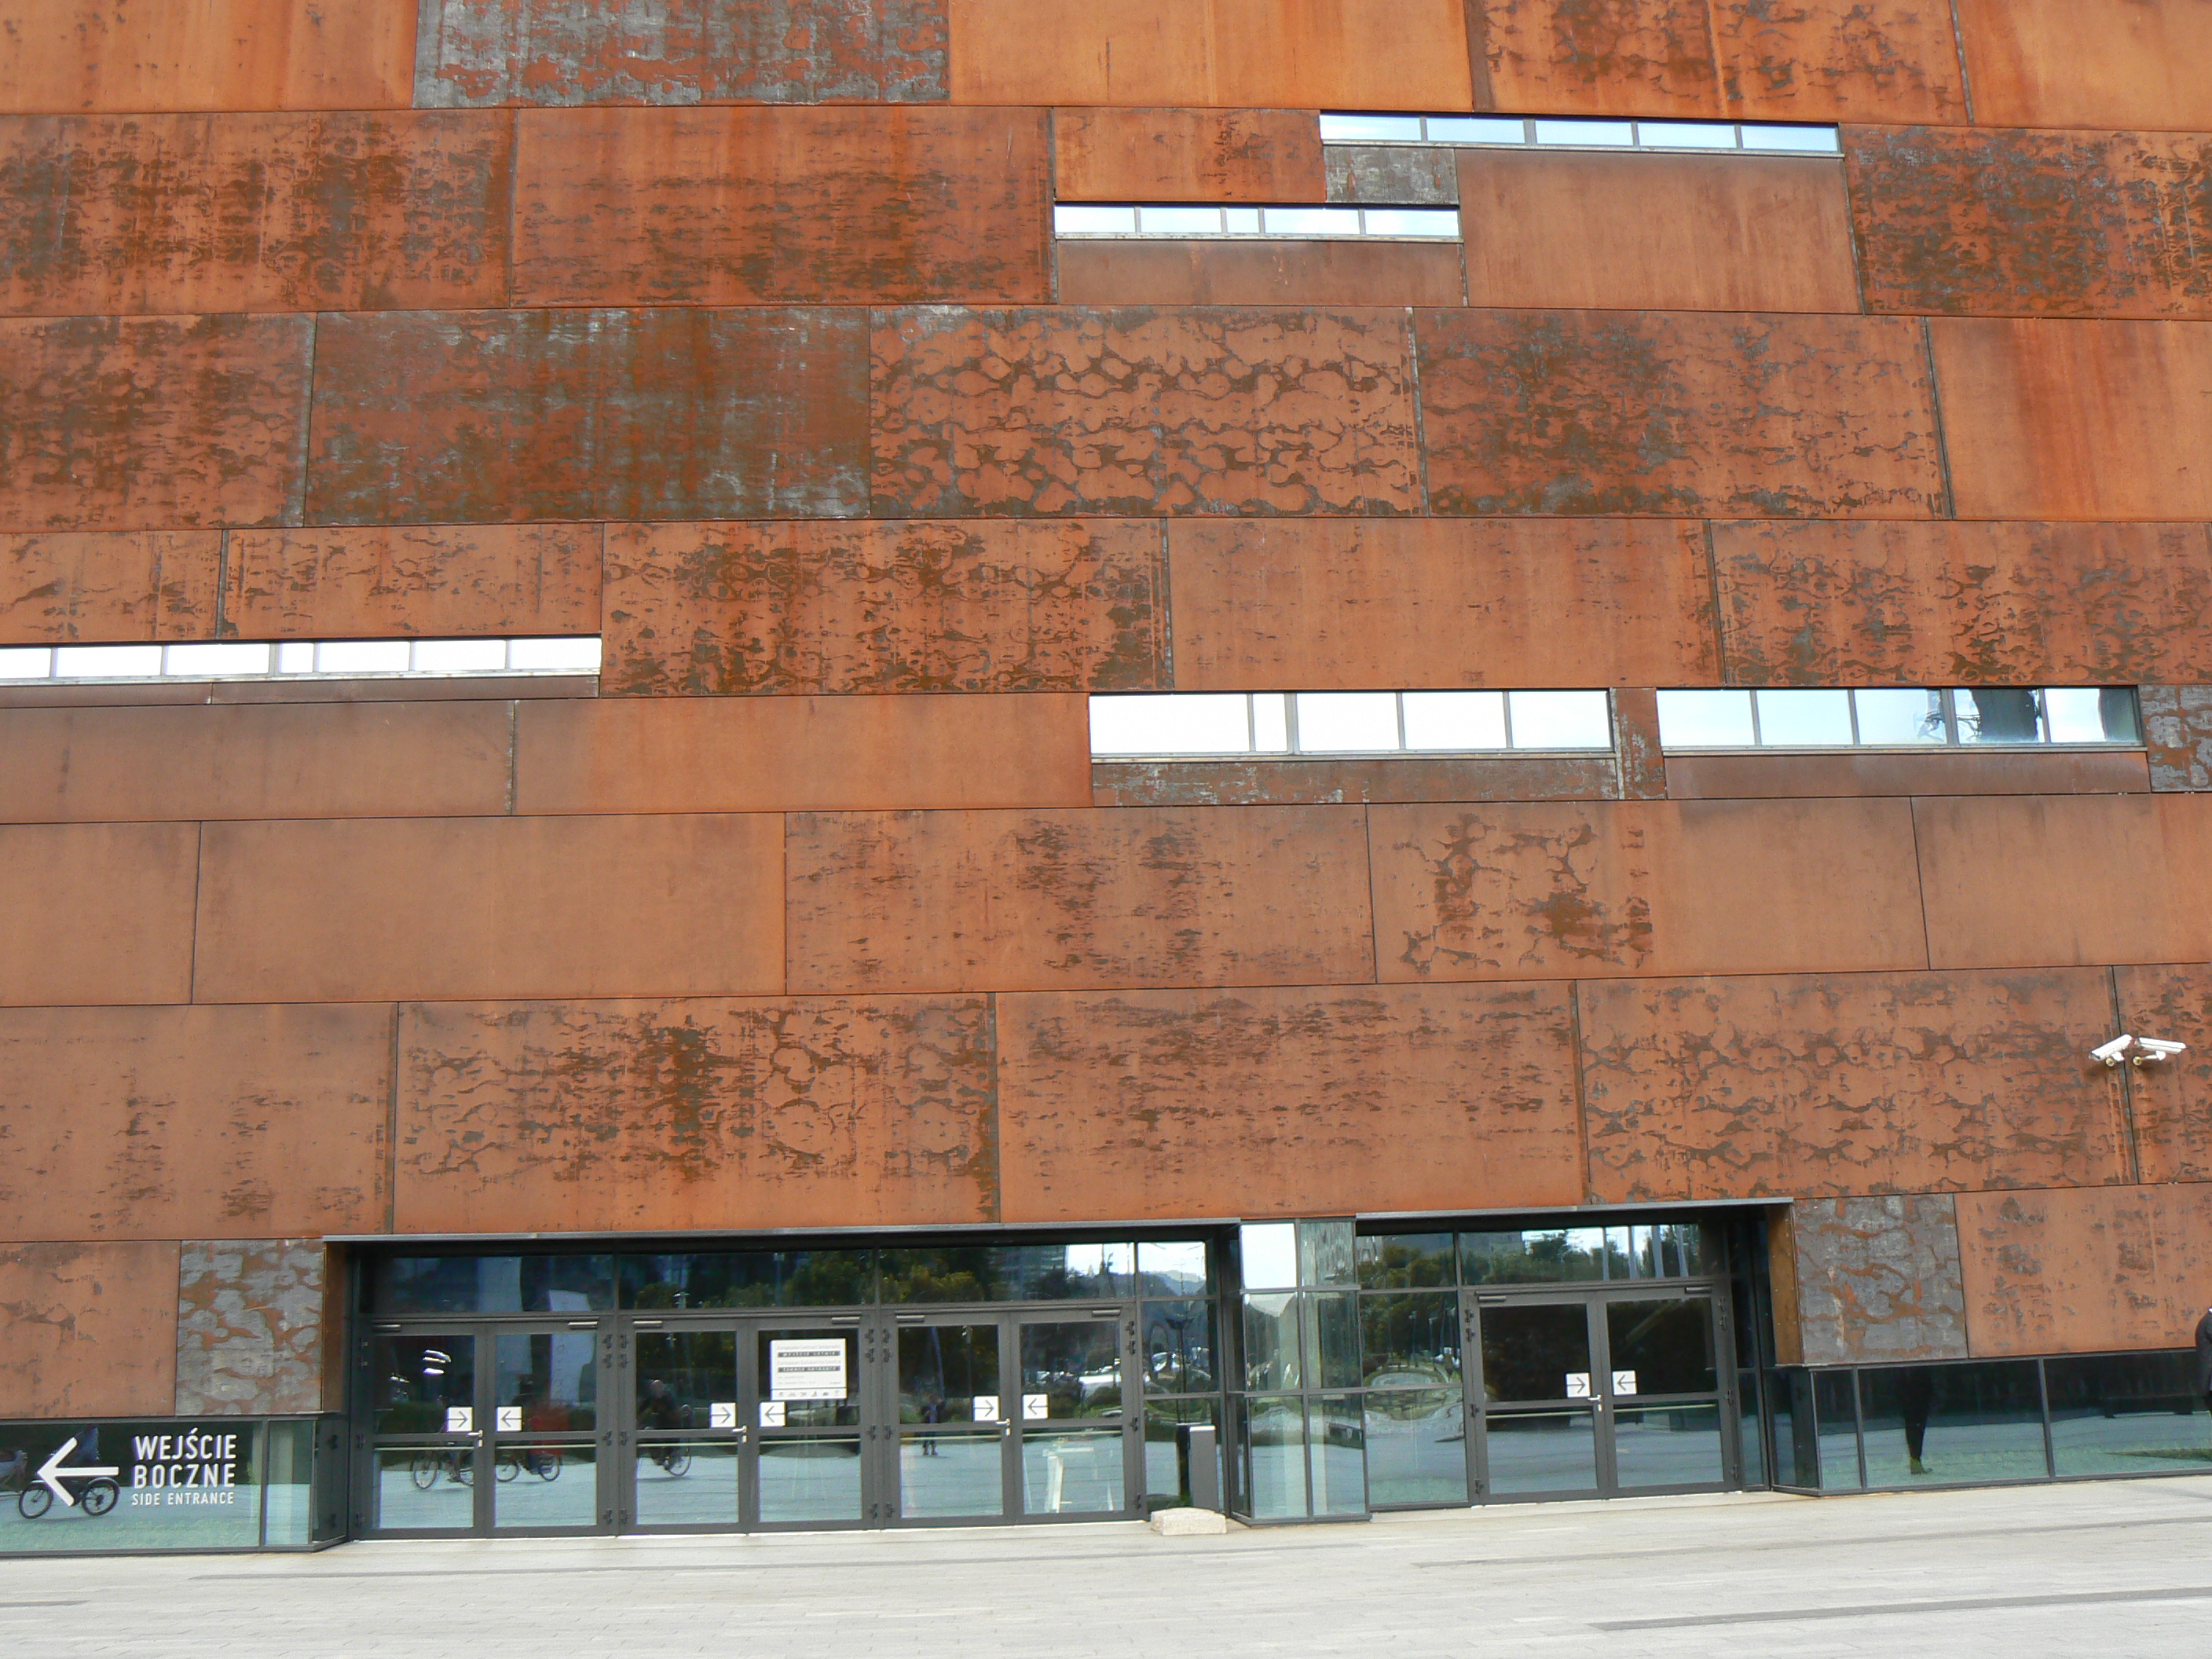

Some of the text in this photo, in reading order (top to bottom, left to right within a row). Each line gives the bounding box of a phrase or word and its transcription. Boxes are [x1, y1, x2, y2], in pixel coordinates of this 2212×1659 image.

[134, 1427, 237, 1460] WEJŚCIE
[134, 1463, 236, 1489] BOCZNE
[132, 1492, 235, 1506] SIDE ENTRANCE
